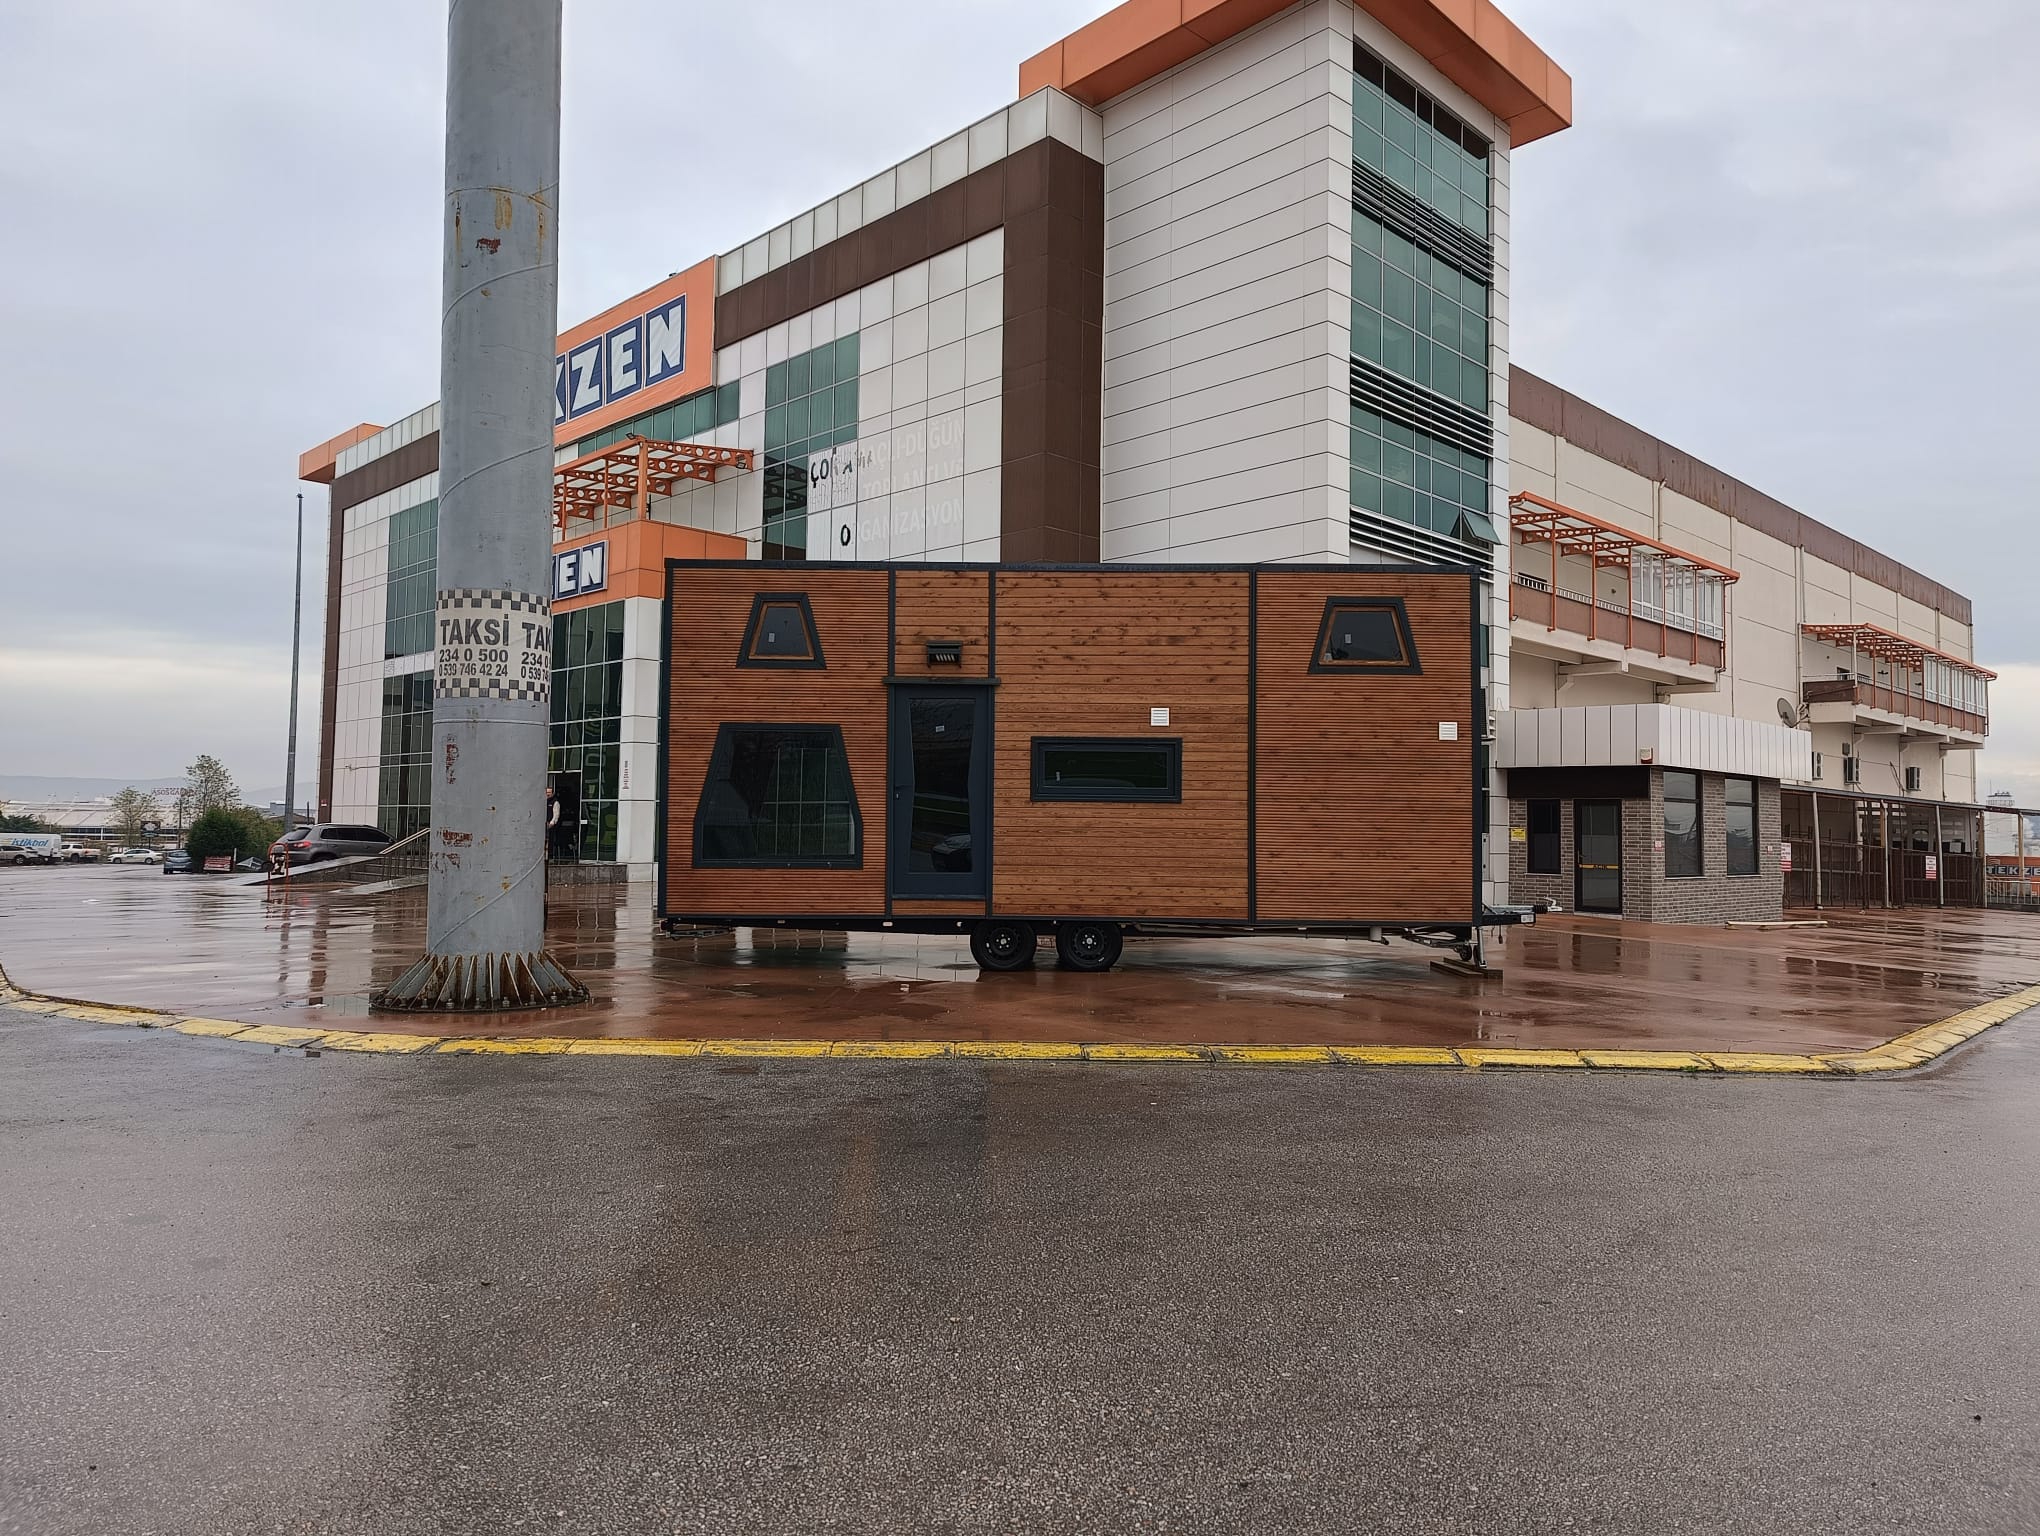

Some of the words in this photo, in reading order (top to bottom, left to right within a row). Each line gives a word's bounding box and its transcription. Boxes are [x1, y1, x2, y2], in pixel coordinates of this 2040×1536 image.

[552, 547, 603, 595] EN
[441, 614, 509, 646] TAKSİ
[440, 649, 459, 662] 234
[464, 649, 472, 661] 0
[479, 649, 508, 662] 500
[521, 652, 542, 667] 234
[460, 664, 476, 677] 746
[480, 664, 492, 676] 42
[496, 664, 508, 677] 24
[521, 666, 526, 678] 0
